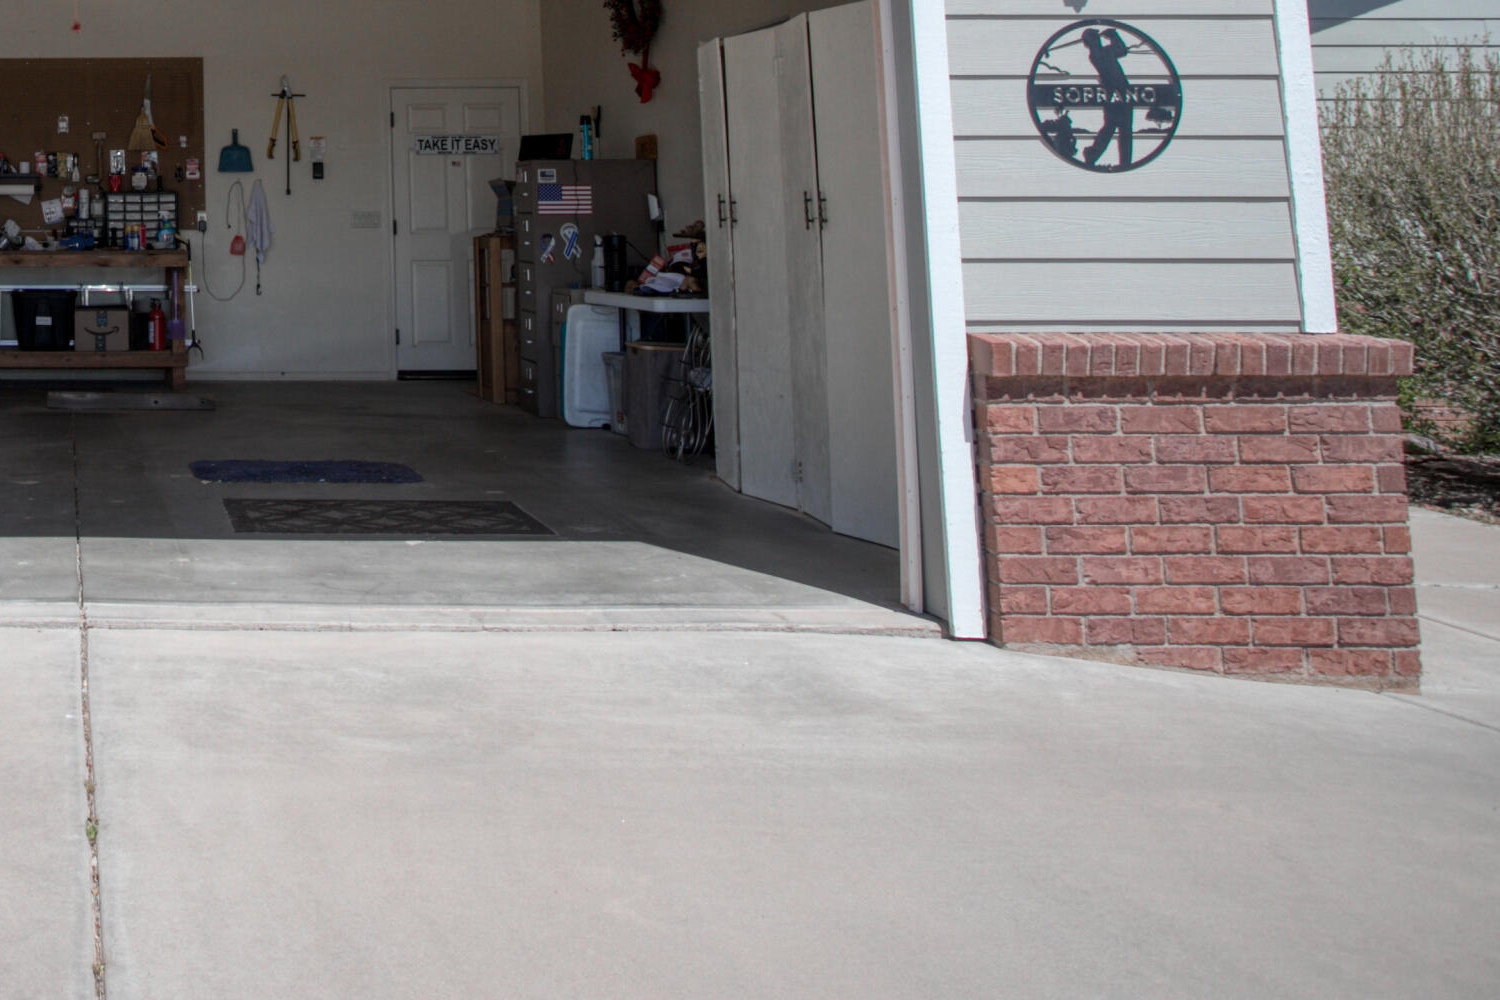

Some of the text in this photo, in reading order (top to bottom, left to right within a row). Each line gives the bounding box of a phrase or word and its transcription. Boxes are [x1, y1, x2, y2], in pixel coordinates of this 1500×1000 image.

[1052, 86, 1157, 104] SOPRANO
[417, 139, 496, 151] TAKE IT EASY
